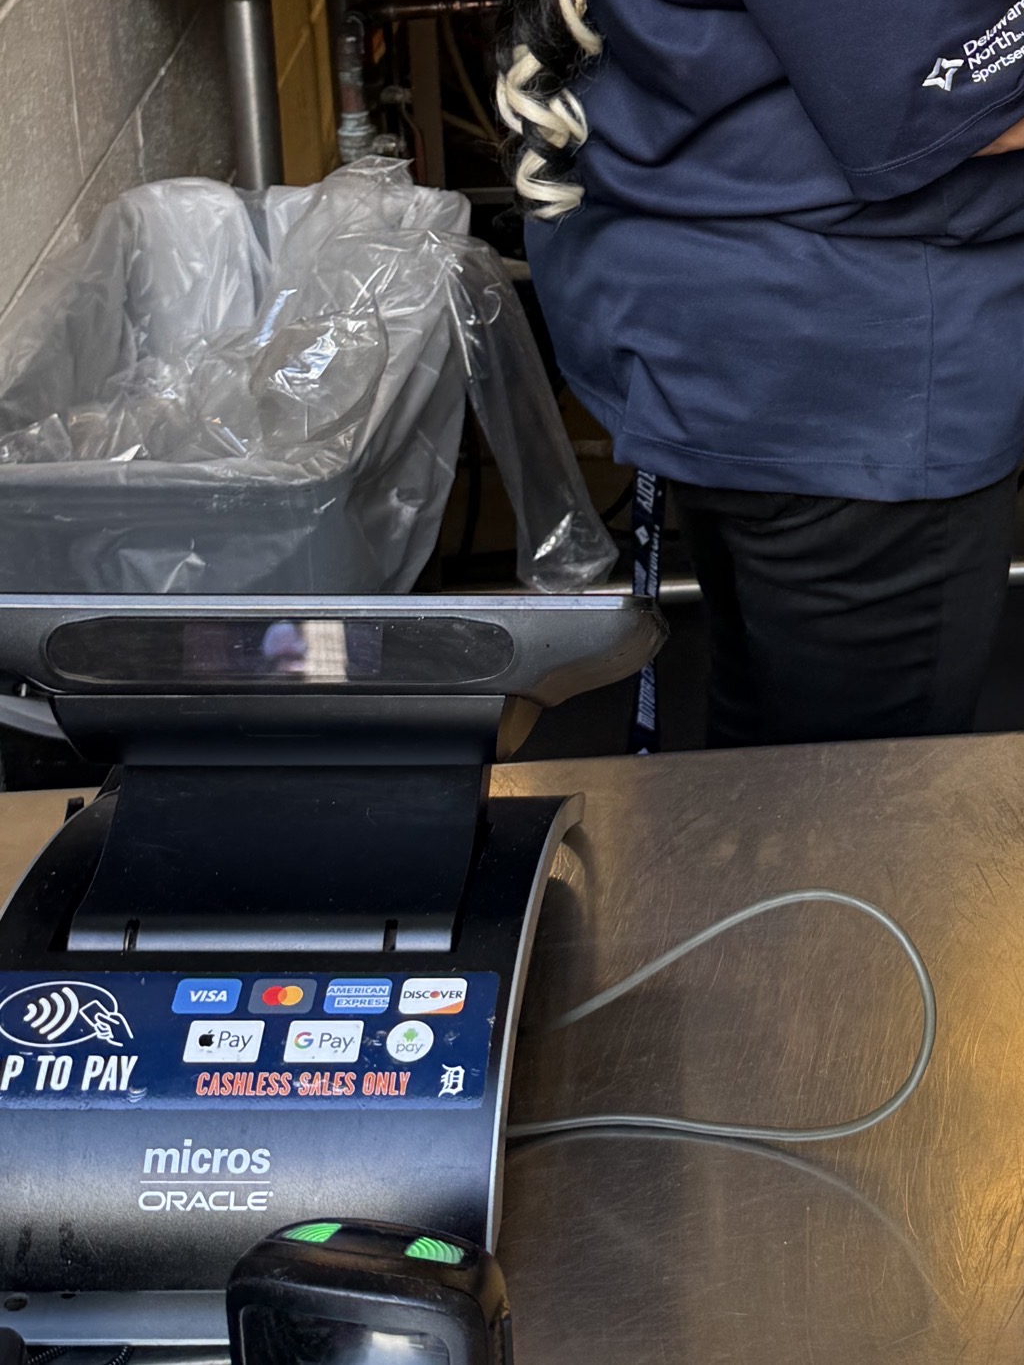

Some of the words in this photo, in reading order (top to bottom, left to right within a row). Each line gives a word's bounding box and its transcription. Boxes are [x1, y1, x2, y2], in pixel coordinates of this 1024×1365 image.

[968, 31, 1018, 70] North
[190, 990, 227, 1002] VISA
[327, 985, 387, 996] AMERICAN
[403, 989, 463, 1000] DISCOVER
[337, 998, 390, 1008] EXPRESS
[217, 1031, 253, 1052] Pay
[318, 1032, 353, 1053] Pay
[396, 1042, 423, 1055] pay
[35, 1055, 73, 1091] TO
[81, 1055, 138, 1091] PAY
[196, 1072, 291, 1096] CASHLESS
[297, 1072, 356, 1096] SALES
[362, 1072, 411, 1096] ONLY
[143, 1138, 271, 1174] micros
[138, 1191, 270, 1212] ORACLE
